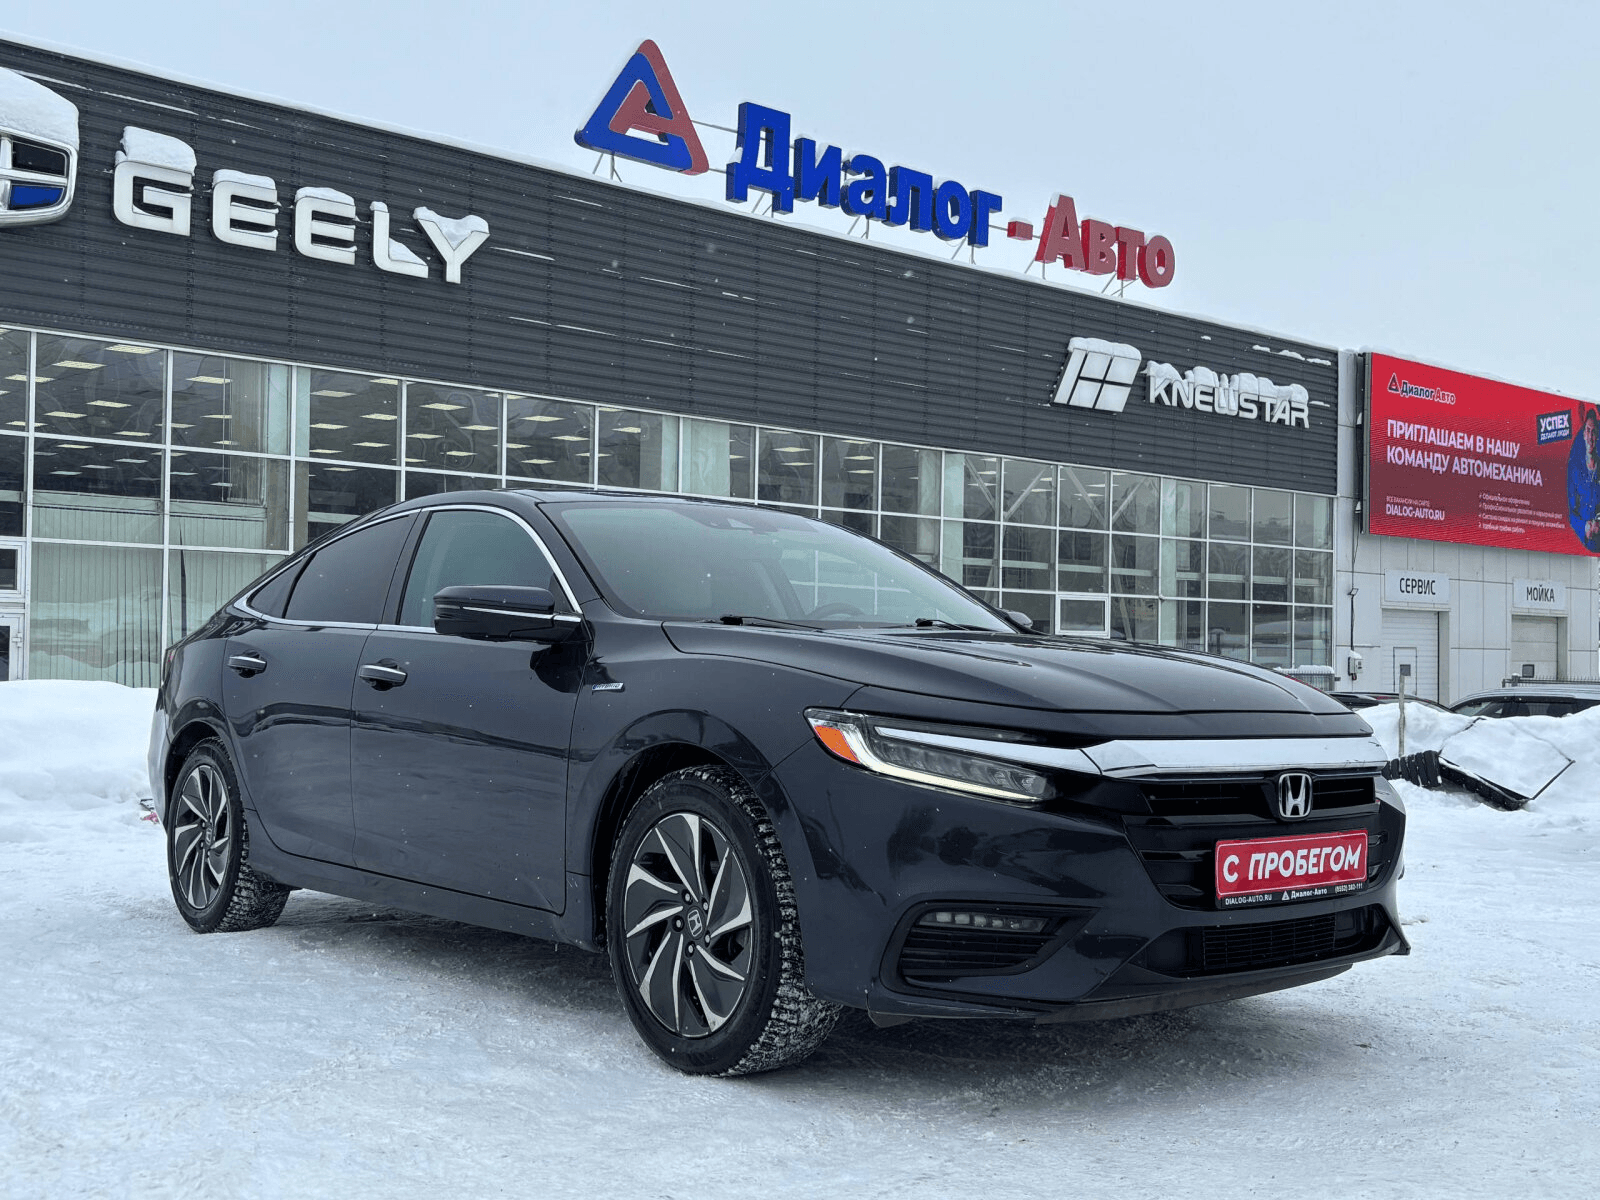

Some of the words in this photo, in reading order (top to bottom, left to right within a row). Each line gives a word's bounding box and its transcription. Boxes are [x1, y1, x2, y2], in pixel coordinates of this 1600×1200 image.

[112, 160, 491, 285] GEELY
[1149, 373, 1310, 429] KNEWSTAR
[1400, 380, 1435, 400] Диалог
[1434, 387, 1456, 405] Авто
[1540, 413, 1569, 432] УСПЕХ
[1387, 419, 1474, 452] ПРИГЛАШАЕМ
[1476, 435, 1484, 453] В
[1486, 438, 1521, 459] НАШУ
[1386, 445, 1450, 474] КОМАНДУ
[1452, 456, 1543, 487] АВТОМЕХАНИКА
[1386, 503, 1446, 521] DIALOG-AUTO.RU
[1399, 577, 1436, 596] СЕРВИС
[1526, 584, 1555, 602] МОЙКА
[1223, 854, 1240, 883] С
[1248, 843, 1363, 881] ПРОБЕГОМ
[1225, 893, 1273, 906] DIALOG-AUTO.RU
